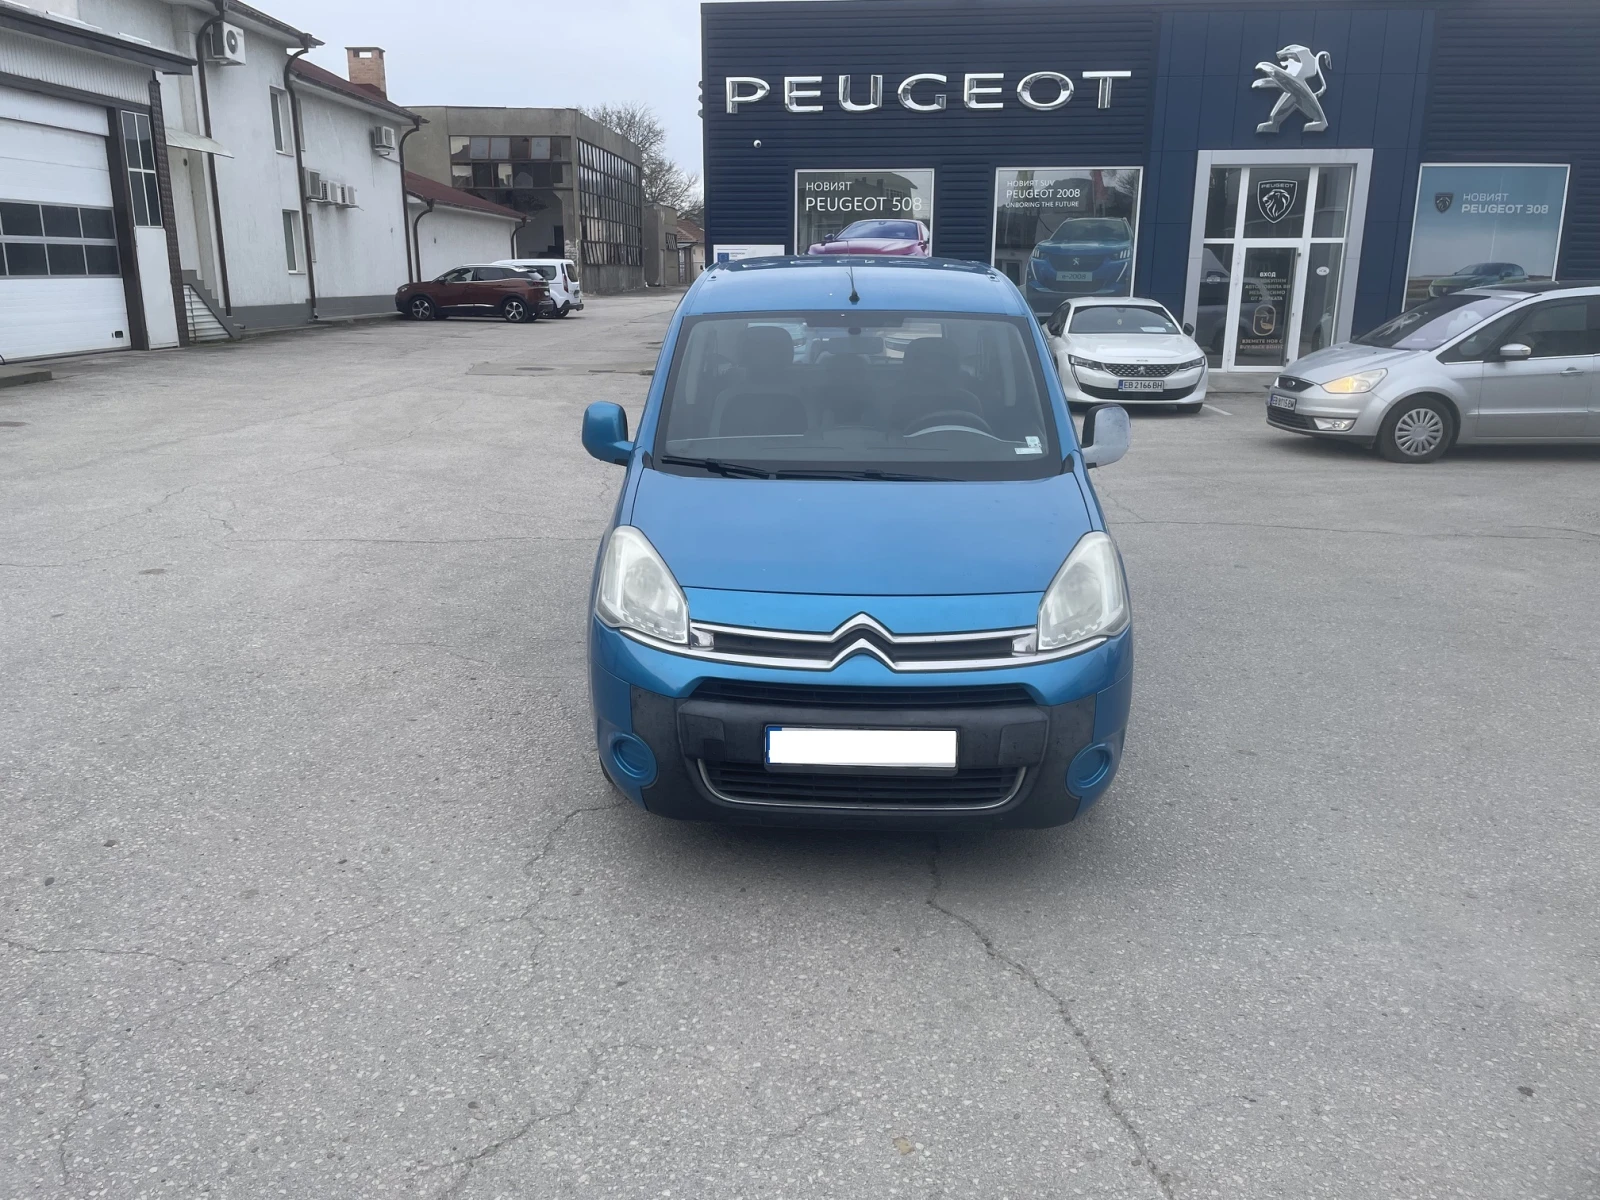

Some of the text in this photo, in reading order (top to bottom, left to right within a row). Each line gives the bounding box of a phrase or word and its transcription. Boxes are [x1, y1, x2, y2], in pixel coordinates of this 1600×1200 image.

[725, 70, 1132, 114] PEUGEOT
[805, 181, 853, 191] НОВИЯТ
[1040, 179, 1056, 187] SUV
[1006, 188, 1081, 199] PEUGEOT 2008
[1463, 193, 1509, 202] НОВИЯТ
[805, 196, 922, 211] PEUGEOT 508
[1055, 200, 1079, 208] FUTURE
[1461, 204, 1549, 214] PEUGEOT 308
[1123, 381, 1163, 390] EB 2166 BH
